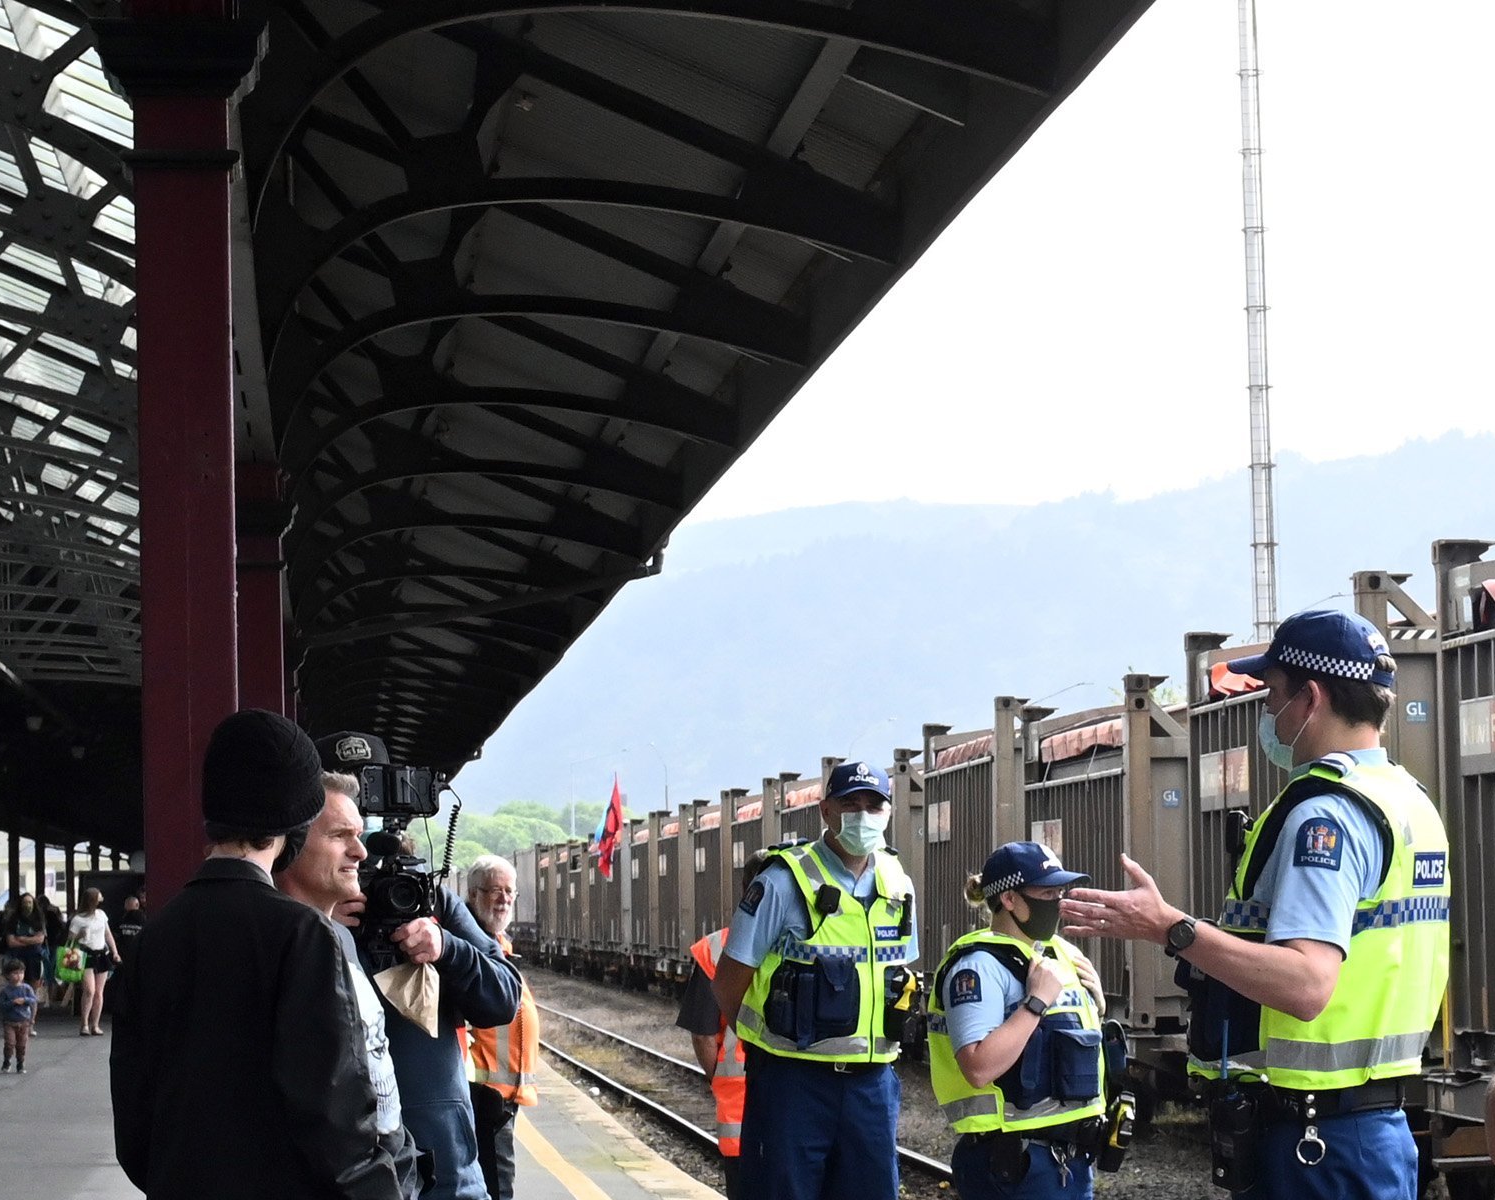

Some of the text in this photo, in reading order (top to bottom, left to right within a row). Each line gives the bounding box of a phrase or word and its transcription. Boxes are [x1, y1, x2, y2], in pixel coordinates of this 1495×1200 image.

[1406, 702, 1426, 716] GL
[849, 774, 880, 786] POLICE
[1163, 790, 1178, 802] GL
[1300, 855, 1337, 867] POLICE
[1415, 859, 1444, 880] POLICE
